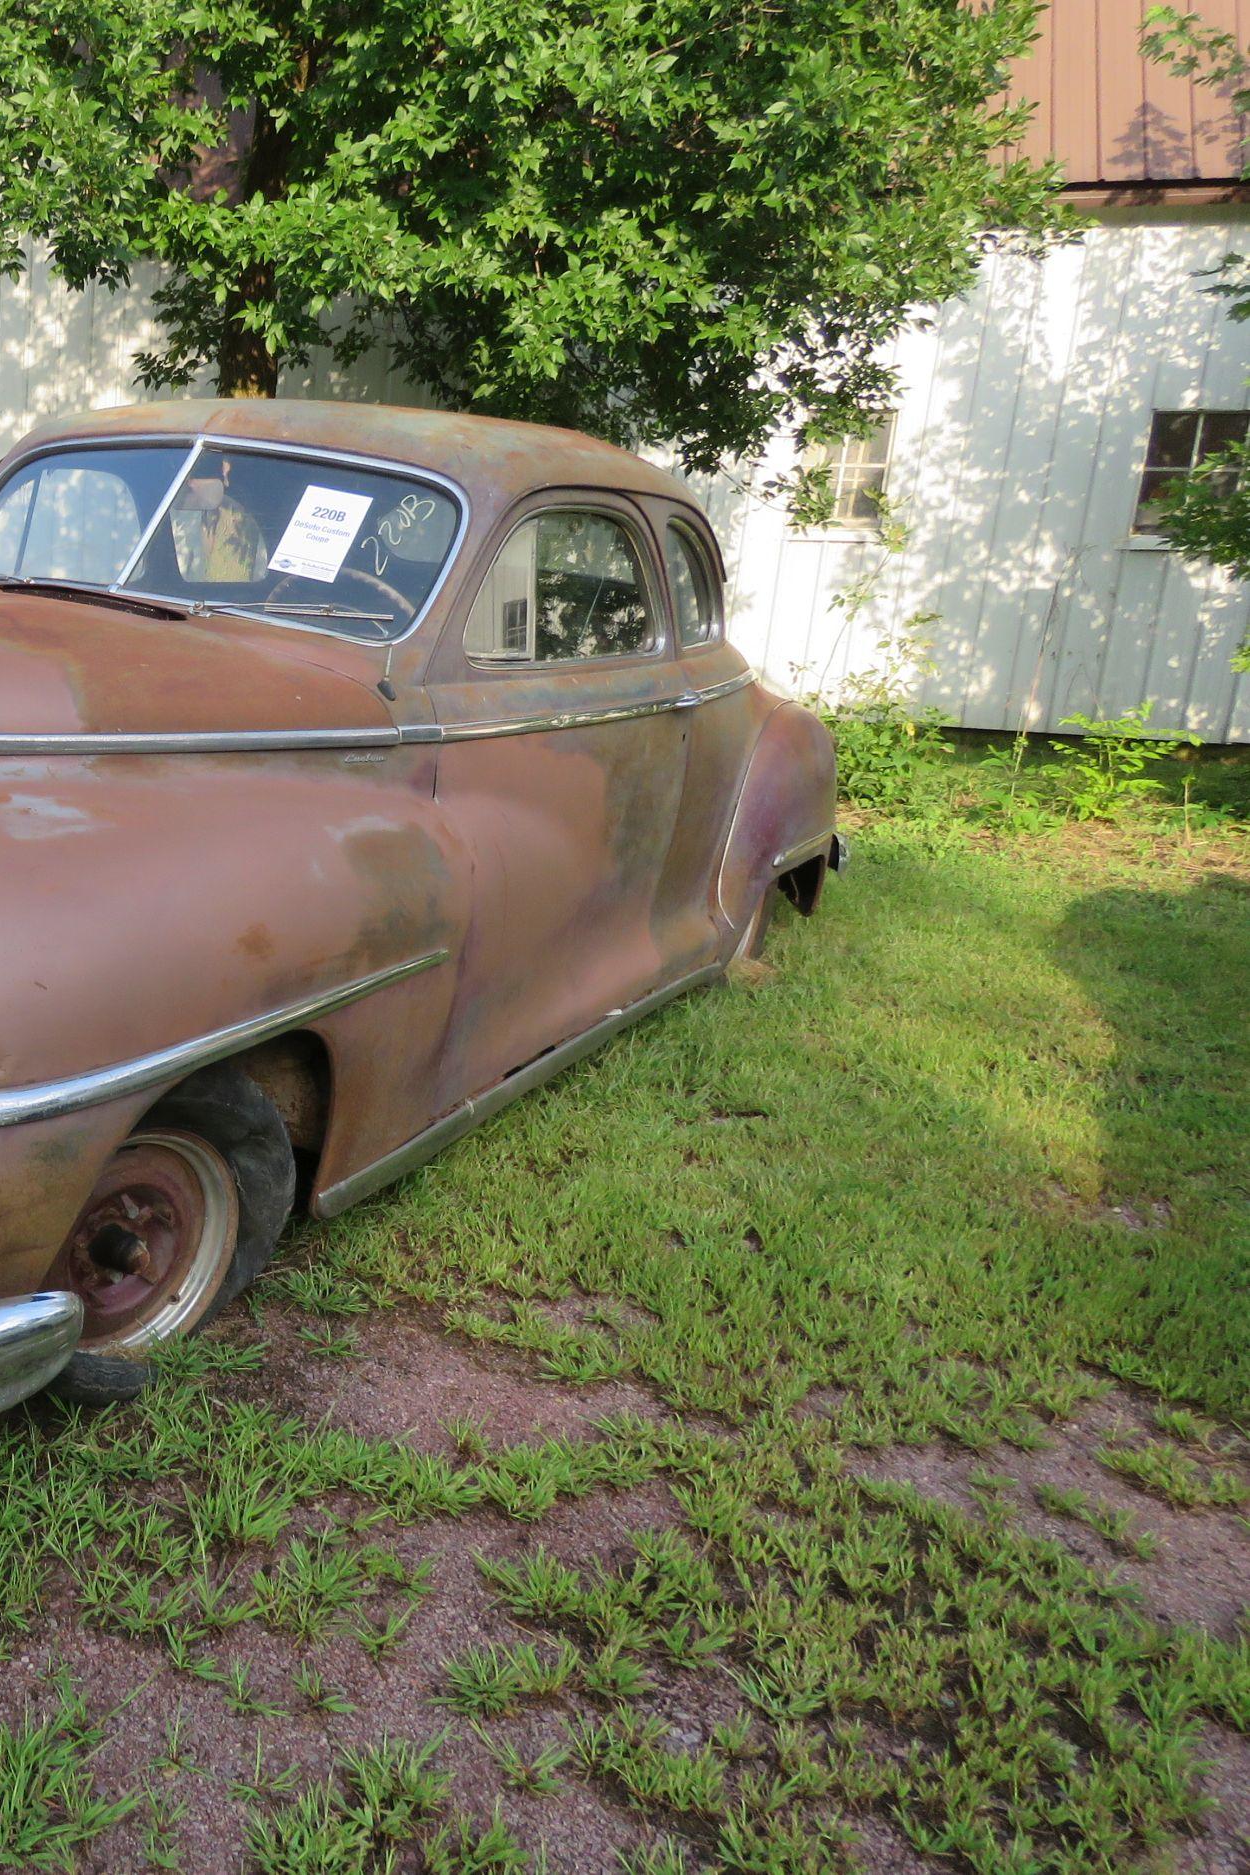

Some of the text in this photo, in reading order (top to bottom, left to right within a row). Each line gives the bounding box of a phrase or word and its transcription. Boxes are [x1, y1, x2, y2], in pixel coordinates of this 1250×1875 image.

[311, 506, 346, 522] 220B
[294, 519, 351, 537] DeSoto Custom
[361, 494, 436, 576] 220B
[305, 532, 330, 544] Coupe
